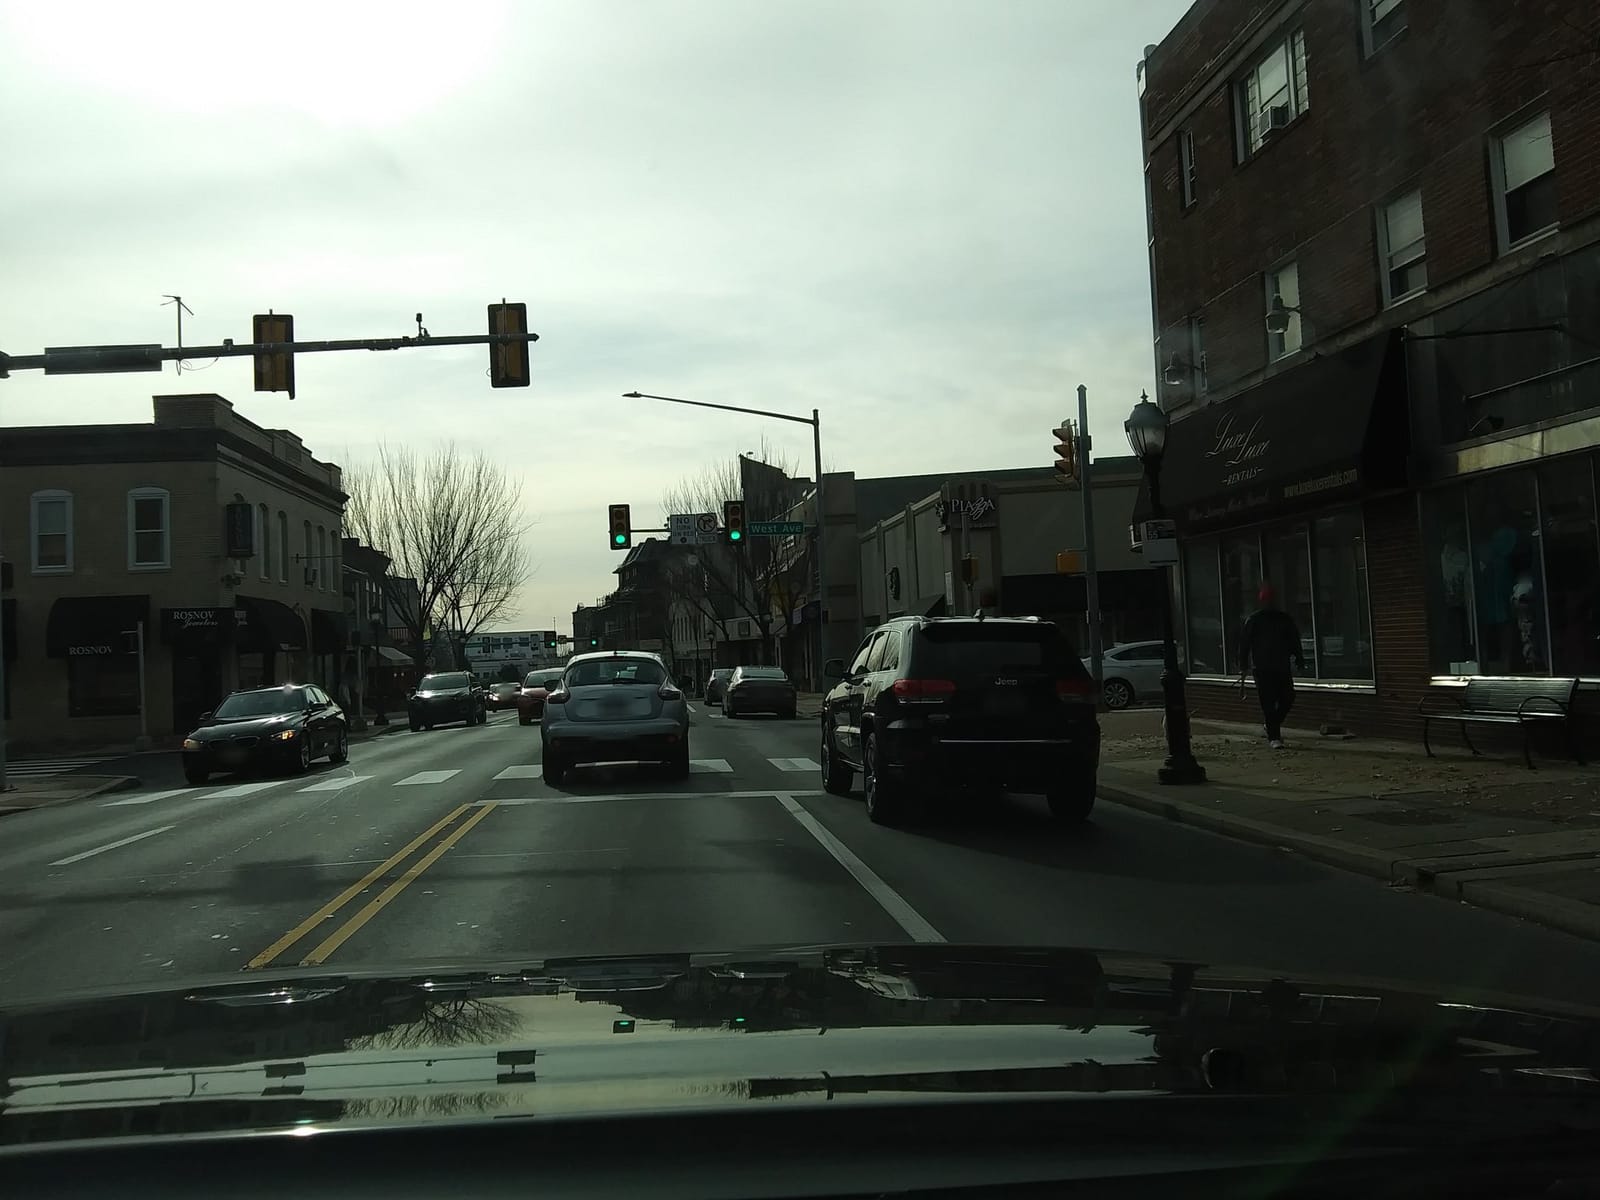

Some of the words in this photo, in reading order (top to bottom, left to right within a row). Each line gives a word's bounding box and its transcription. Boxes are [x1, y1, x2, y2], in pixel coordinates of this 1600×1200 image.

[751, 524, 777, 534] West
[782, 523, 801, 534] Ave
[173, 610, 216, 620] ROSNOV
[68, 646, 112, 655] ROSNOV
[994, 677, 1018, 686] Jeep
